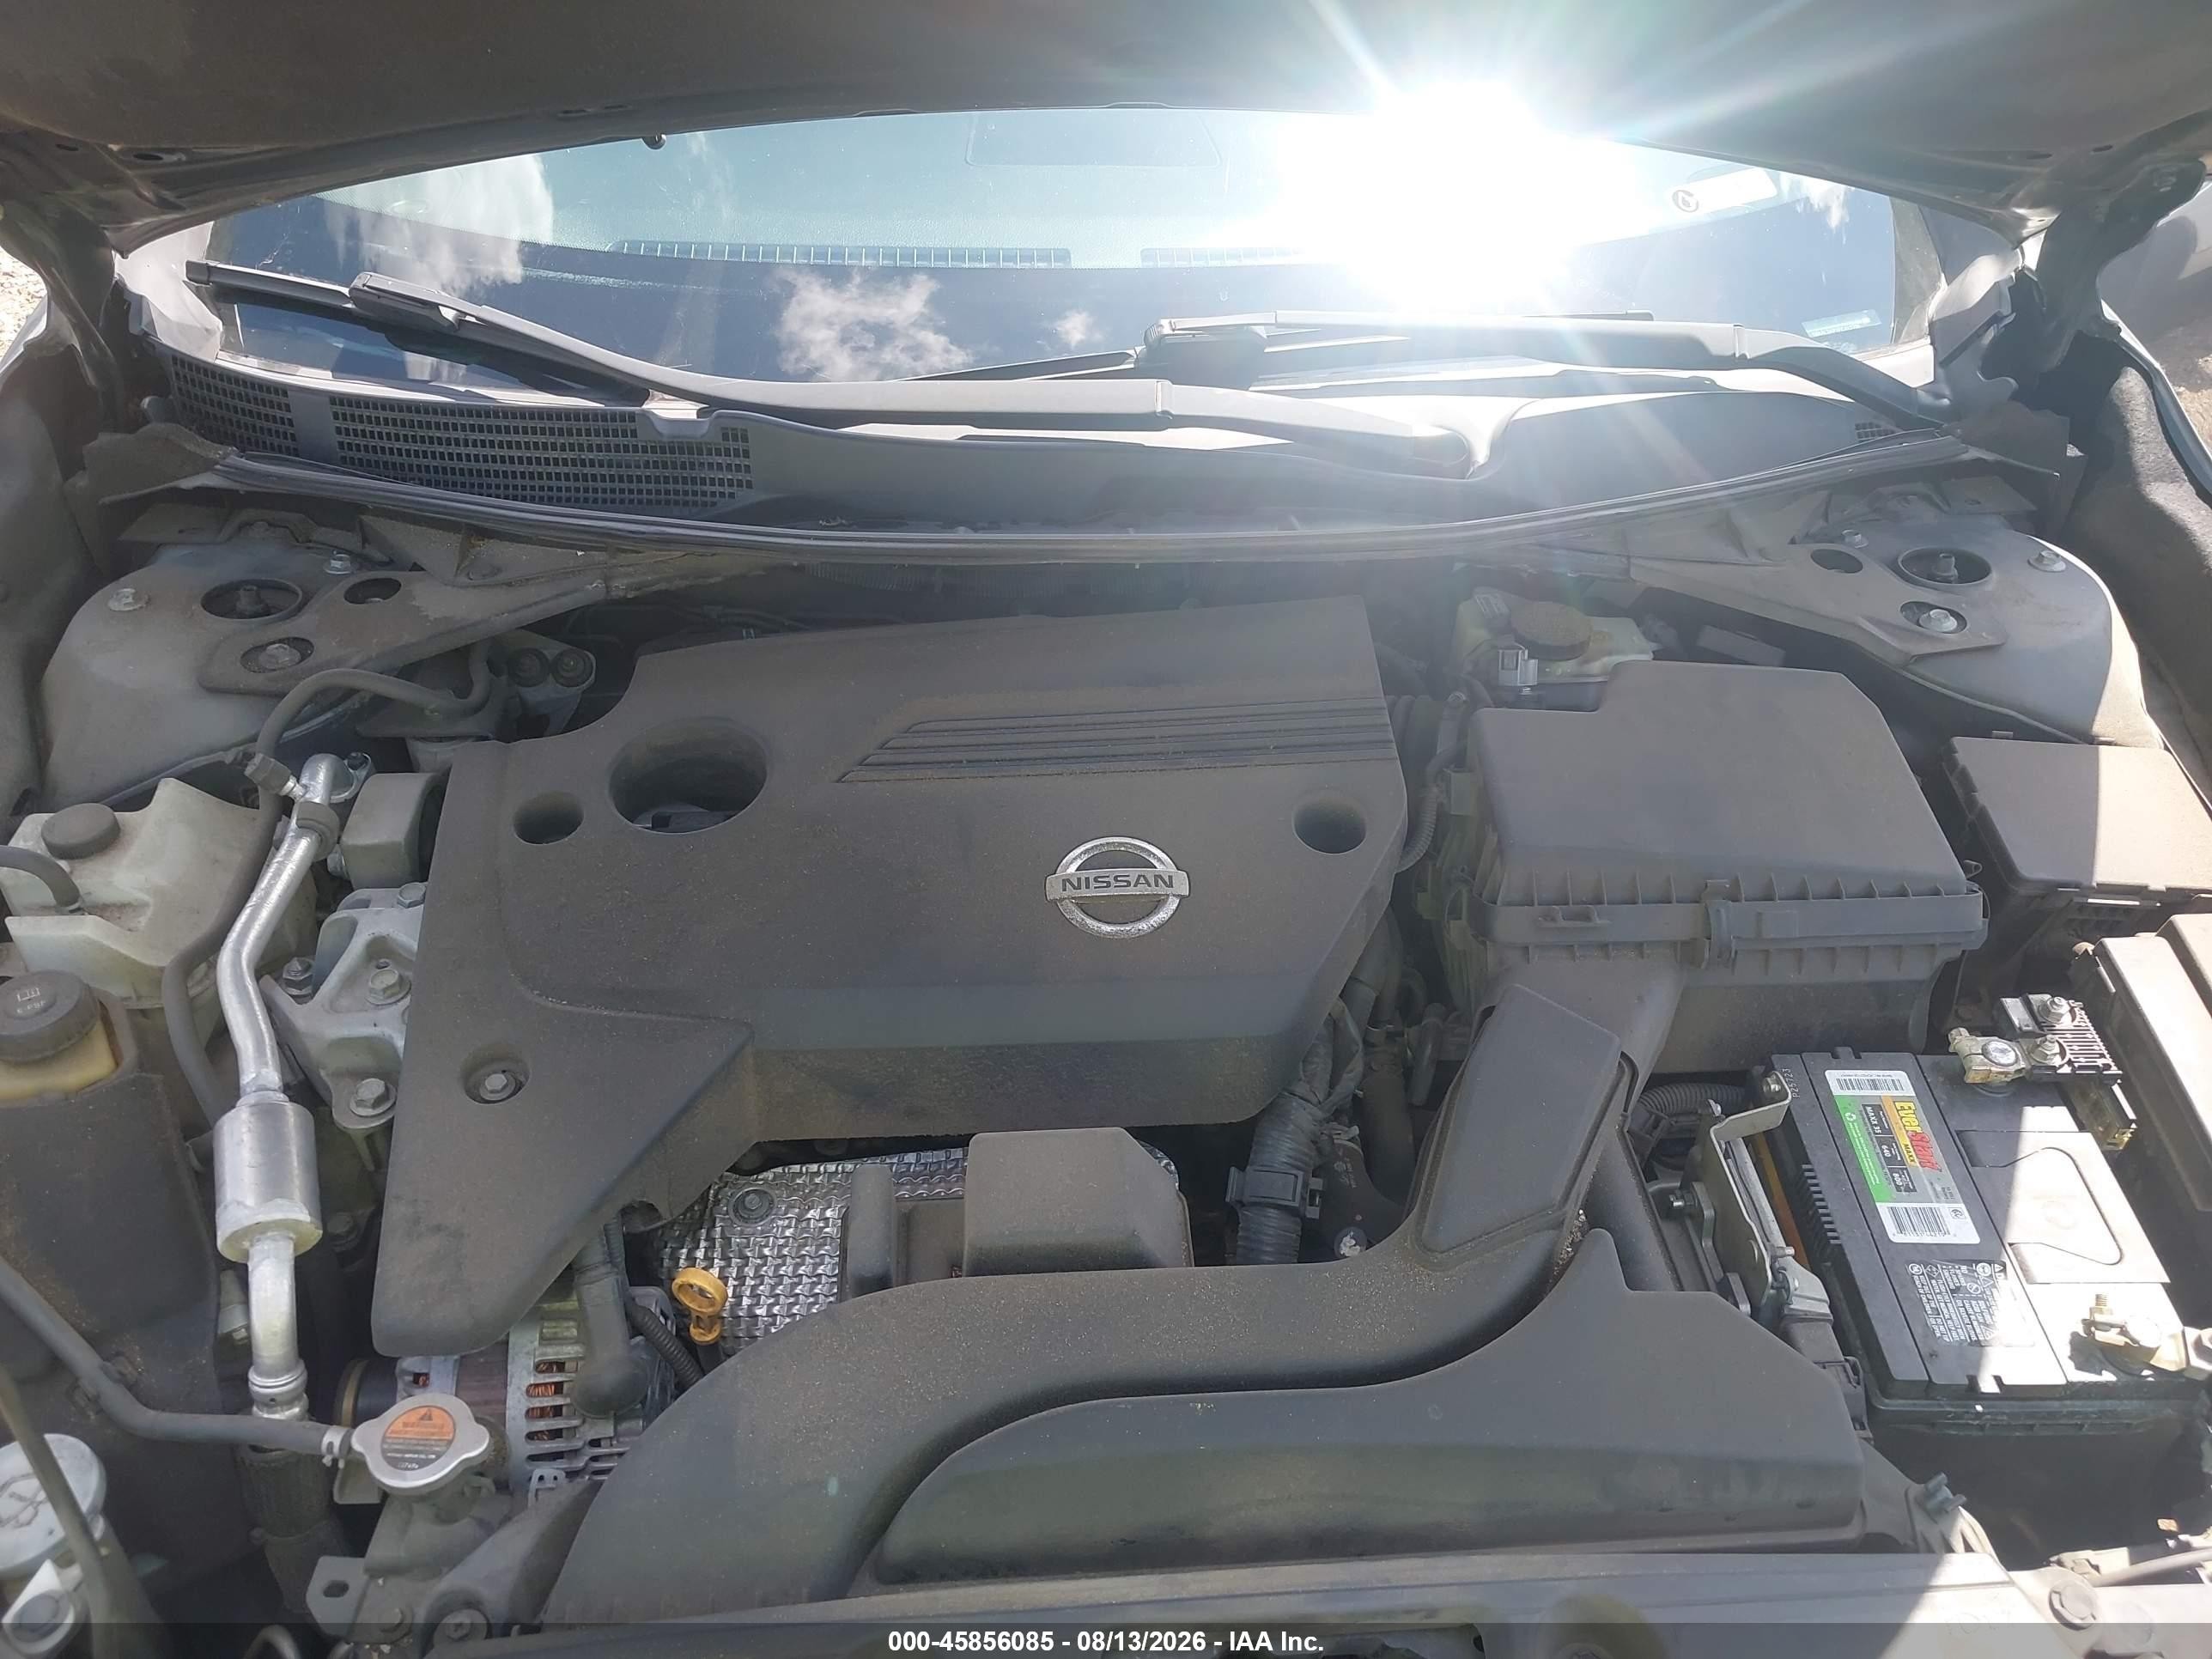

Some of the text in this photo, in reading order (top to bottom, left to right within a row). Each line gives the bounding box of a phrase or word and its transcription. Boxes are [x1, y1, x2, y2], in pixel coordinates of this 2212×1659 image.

[1061, 874, 1174, 892] NISSAN
[1865, 1106, 1878, 1124] MAXX
[1894, 1102, 1941, 1171] EverStart
[1881, 1145, 1891, 1157] 640
[1902, 1143, 1915, 1162] MAXX
[1892, 1173, 1902, 1185] 800
[1962, 1299, 1974, 1314] CAUSE
[1970, 1300, 1984, 1322] ACID CAN
